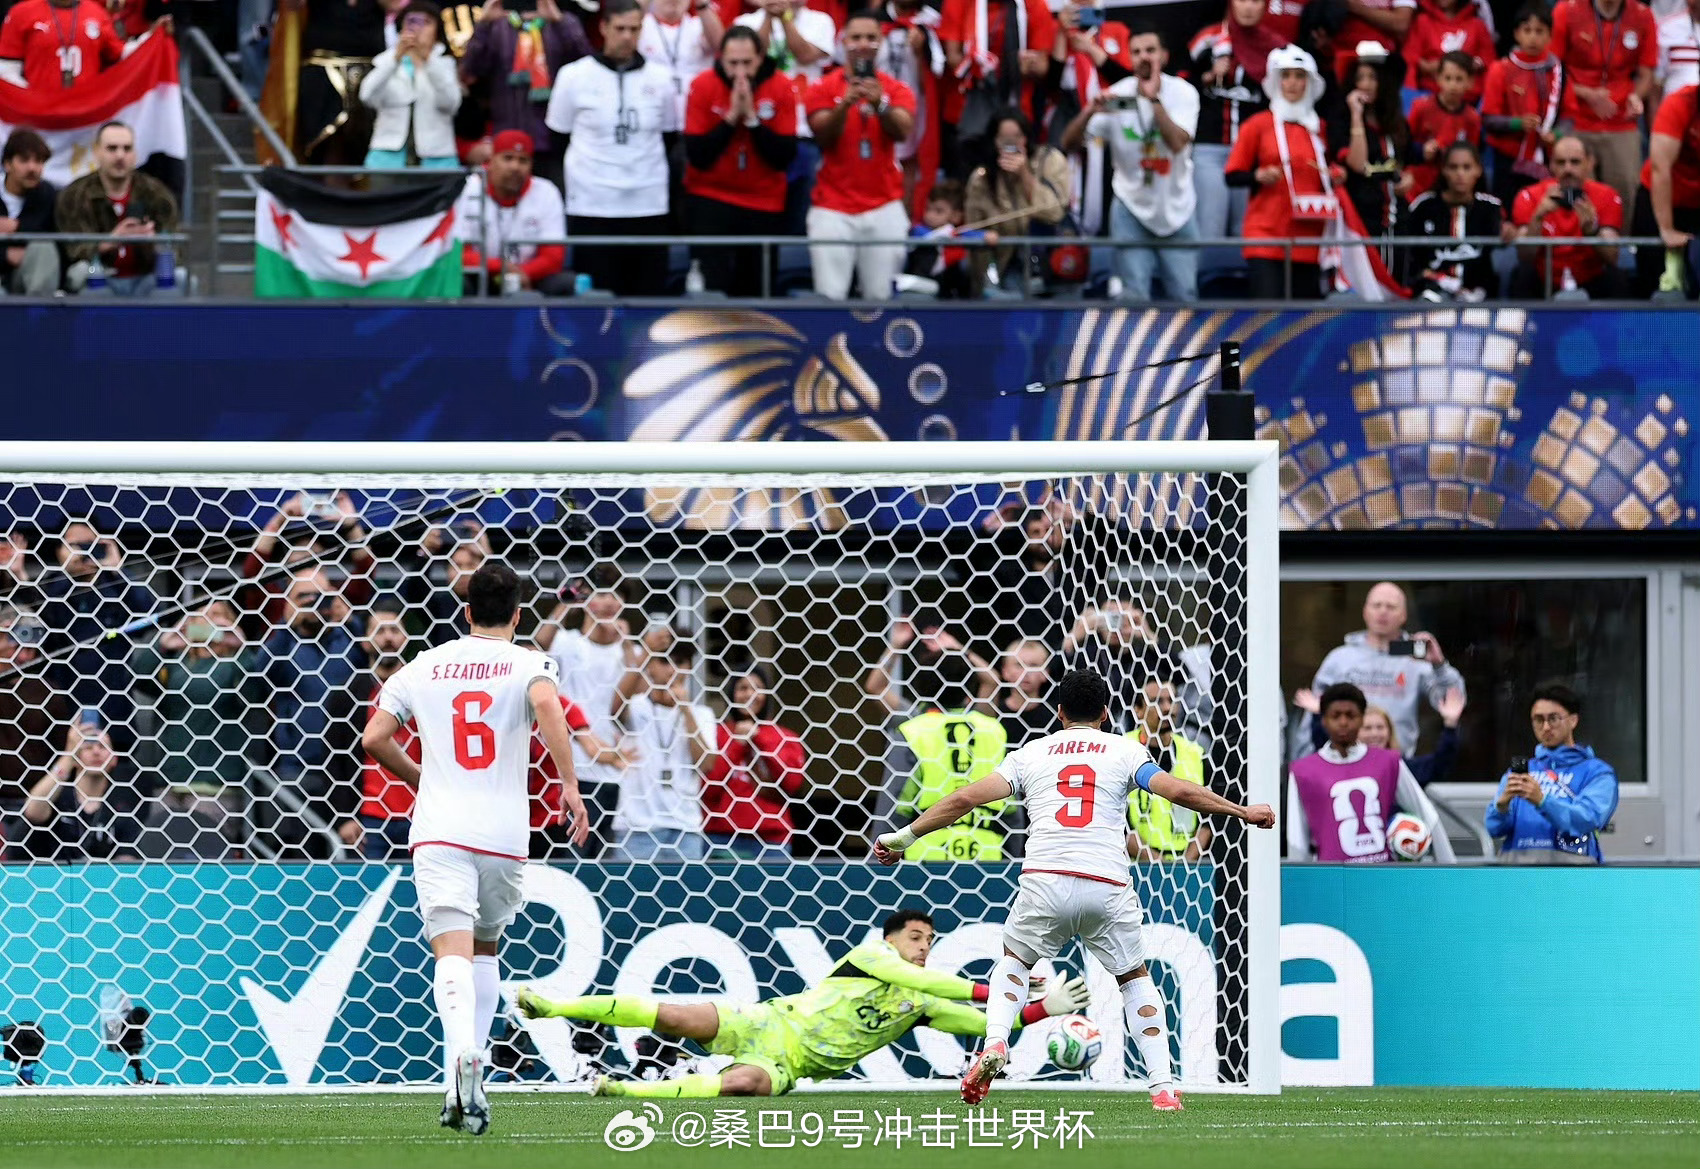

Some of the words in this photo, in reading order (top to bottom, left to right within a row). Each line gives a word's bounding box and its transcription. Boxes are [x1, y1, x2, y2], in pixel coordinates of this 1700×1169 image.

[432, 662, 513, 680] S.EZATOLAHI
[452, 691, 495, 770] 6
[1048, 741, 1107, 755] TAREMI
[1055, 764, 1096, 828] 9
